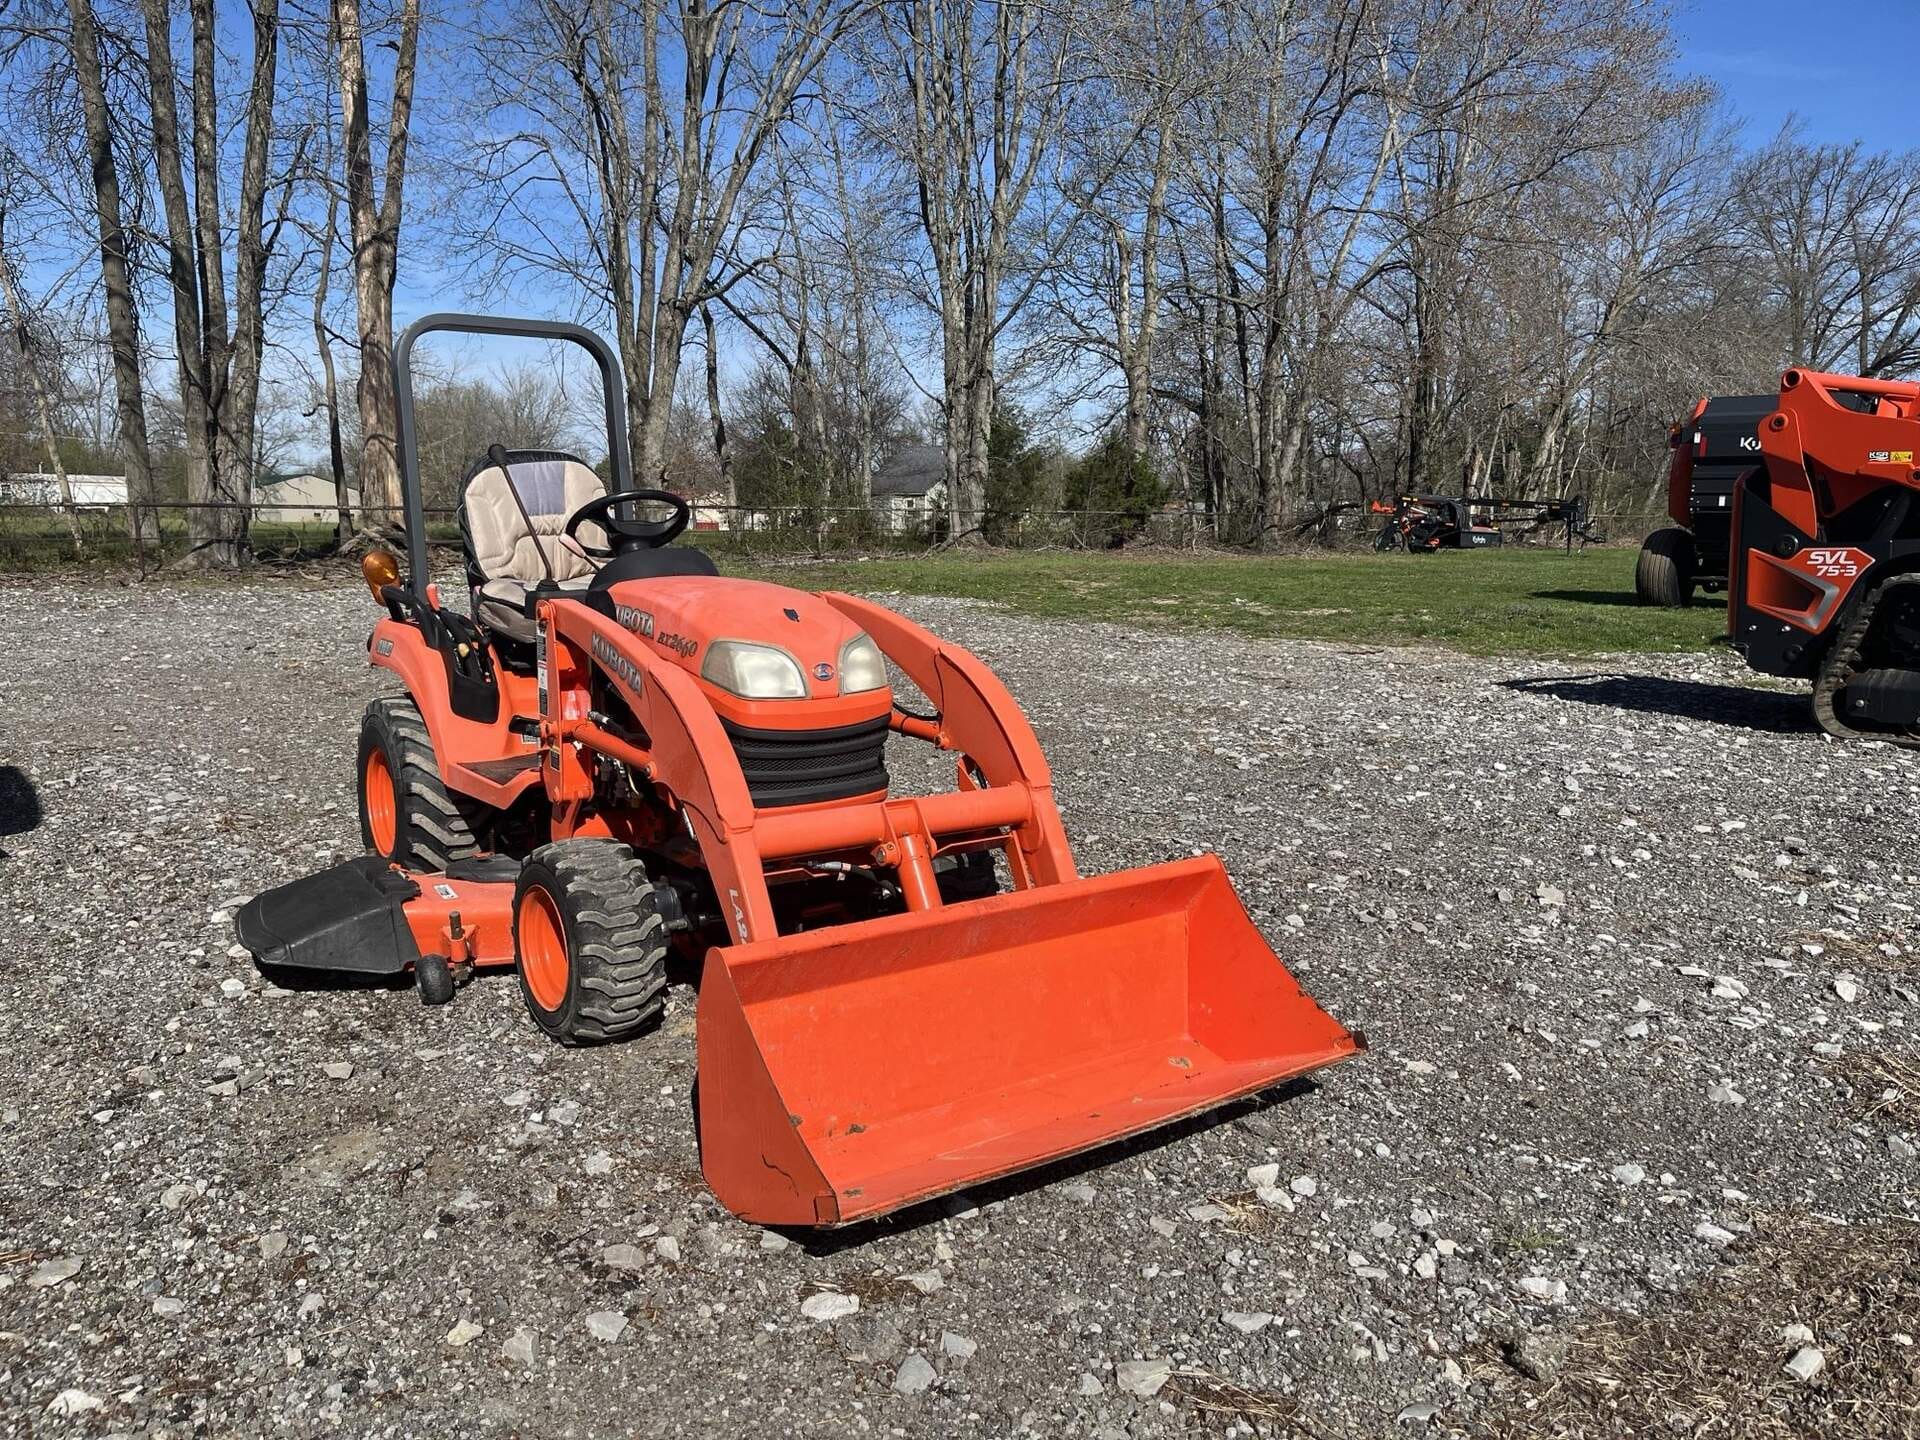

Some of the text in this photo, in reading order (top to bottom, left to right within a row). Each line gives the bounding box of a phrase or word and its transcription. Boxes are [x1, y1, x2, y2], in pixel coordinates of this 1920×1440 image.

[1807, 551, 1855, 565] SVL
[1816, 565, 1858, 577] 75-3
[614, 605, 654, 638] UBOTA
[591, 631, 642, 697] KUBOTA
